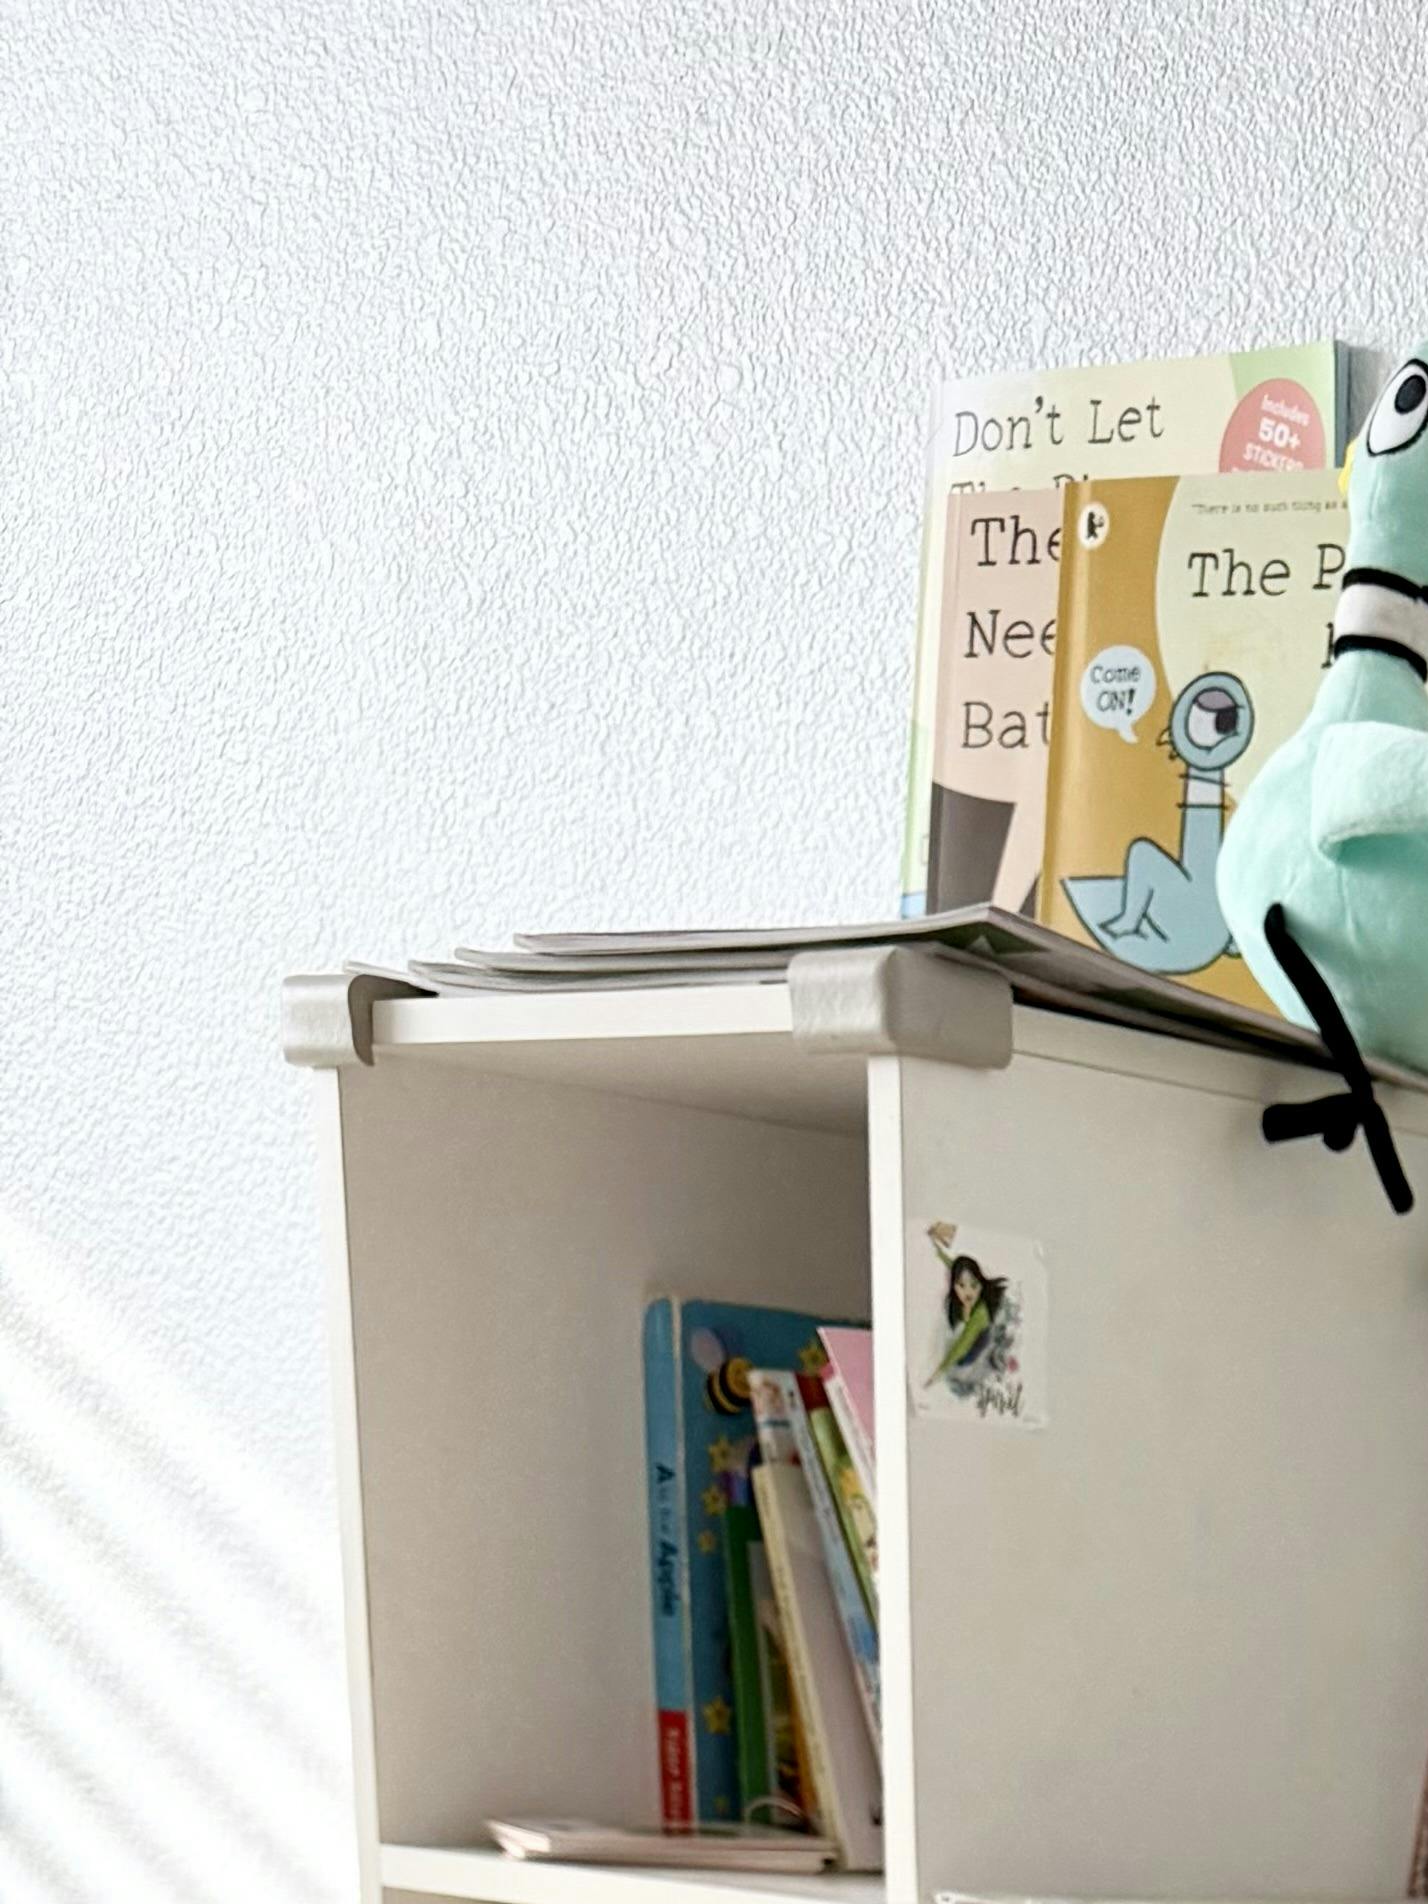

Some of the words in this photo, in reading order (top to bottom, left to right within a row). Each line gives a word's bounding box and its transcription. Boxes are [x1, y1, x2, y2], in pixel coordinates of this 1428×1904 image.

[953, 395, 1064, 456] Don't
[1087, 396, 1165, 445] Let
[1257, 417, 1301, 450] 50+
[1187, 548, 1292, 599] The
[1096, 688, 1137, 716] ON!
